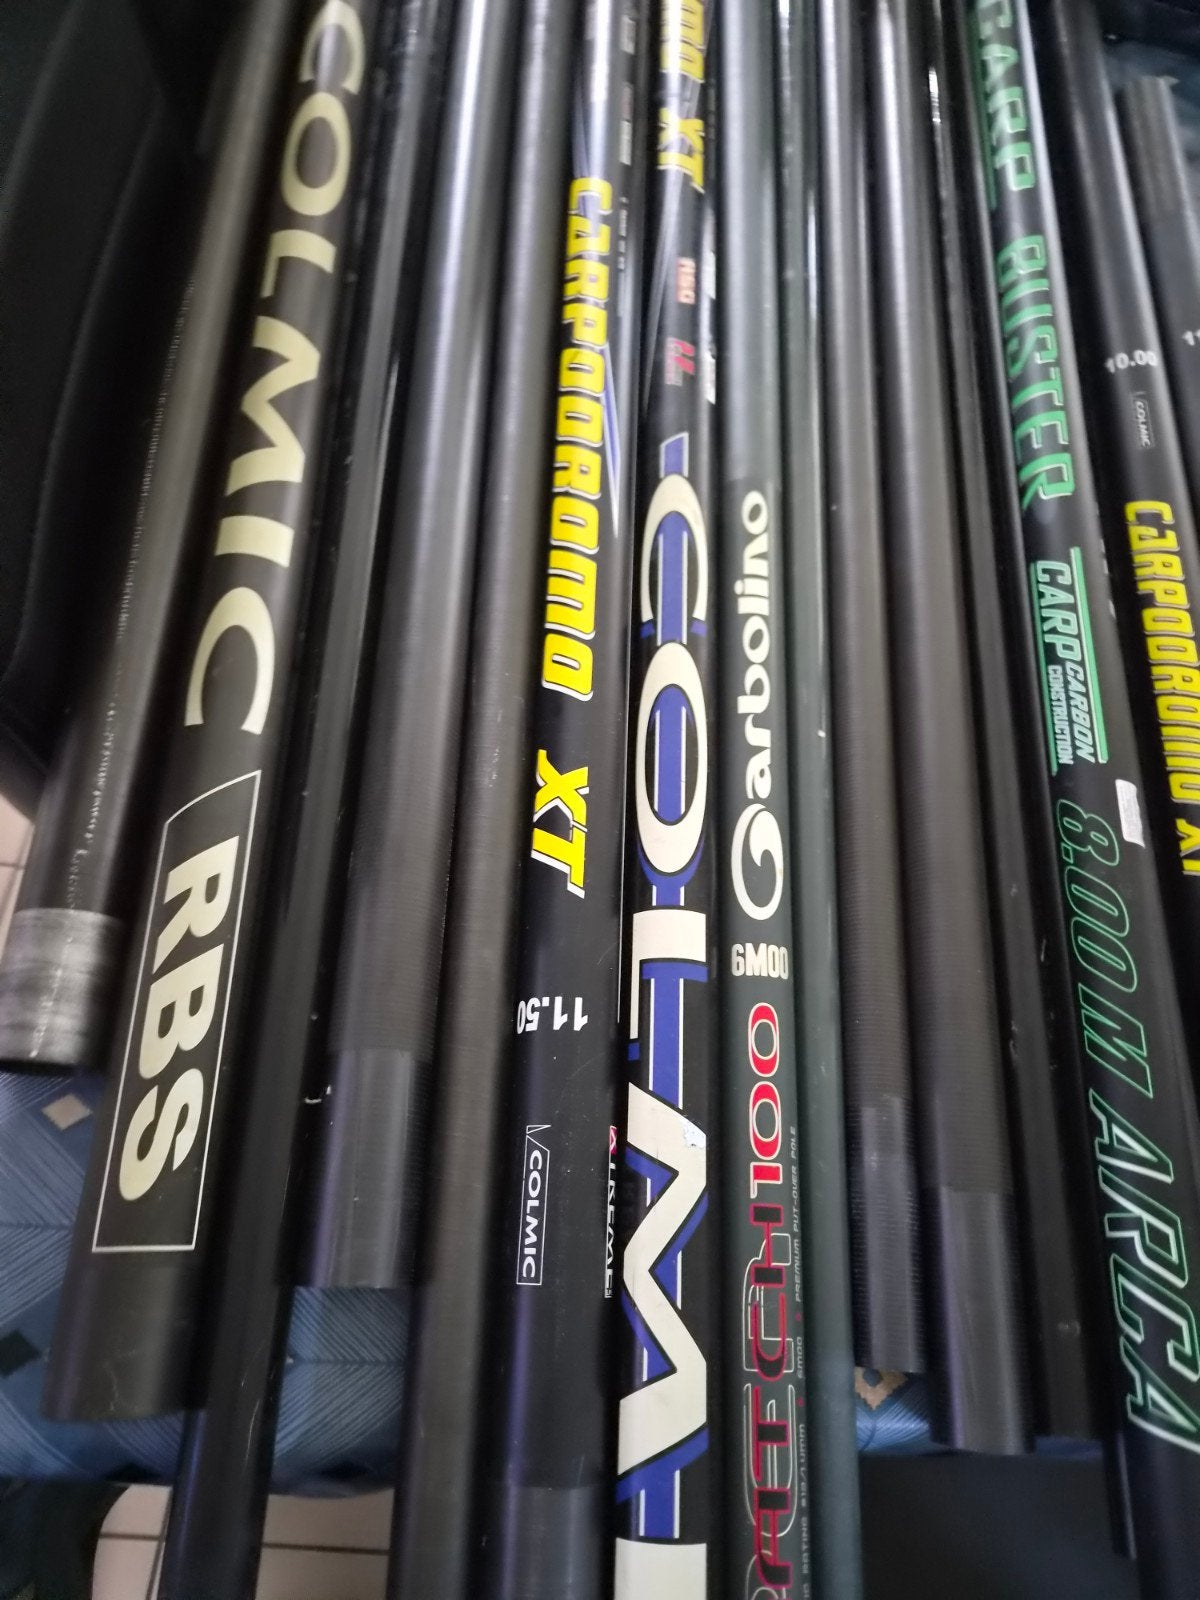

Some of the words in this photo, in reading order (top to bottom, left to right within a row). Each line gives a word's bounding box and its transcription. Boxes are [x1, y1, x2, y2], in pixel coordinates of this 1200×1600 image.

[976, 0, 1036, 191] CARP
[185, 0, 366, 735] COLMIC
[541, 178, 613, 702] CARPODROMO
[998, 235, 1076, 510] BUSTER
[1105, 349, 1159, 374] 10.00
[731, 489, 784, 921] Garbolino
[1037, 560, 1083, 662] CARP
[1065, 660, 1097, 764] CARBON
[1046, 664, 1074, 765] CONSTRUCTION
[1124, 500, 1200, 804] CARPODROMO
[531, 749, 590, 899] XT
[119, 834, 240, 1201] RBS
[516, 995, 589, 1035] 11.50
[731, 942, 790, 980] 6M00
[521, 1148, 544, 1279] COLMIC
[789, 1125, 799, 1160] POLE
[790, 1165, 800, 1233] PUT-OVER
[792, 1238, 802, 1303] PREMIUM
[1089, 1087, 1200, 1454] ARCA
